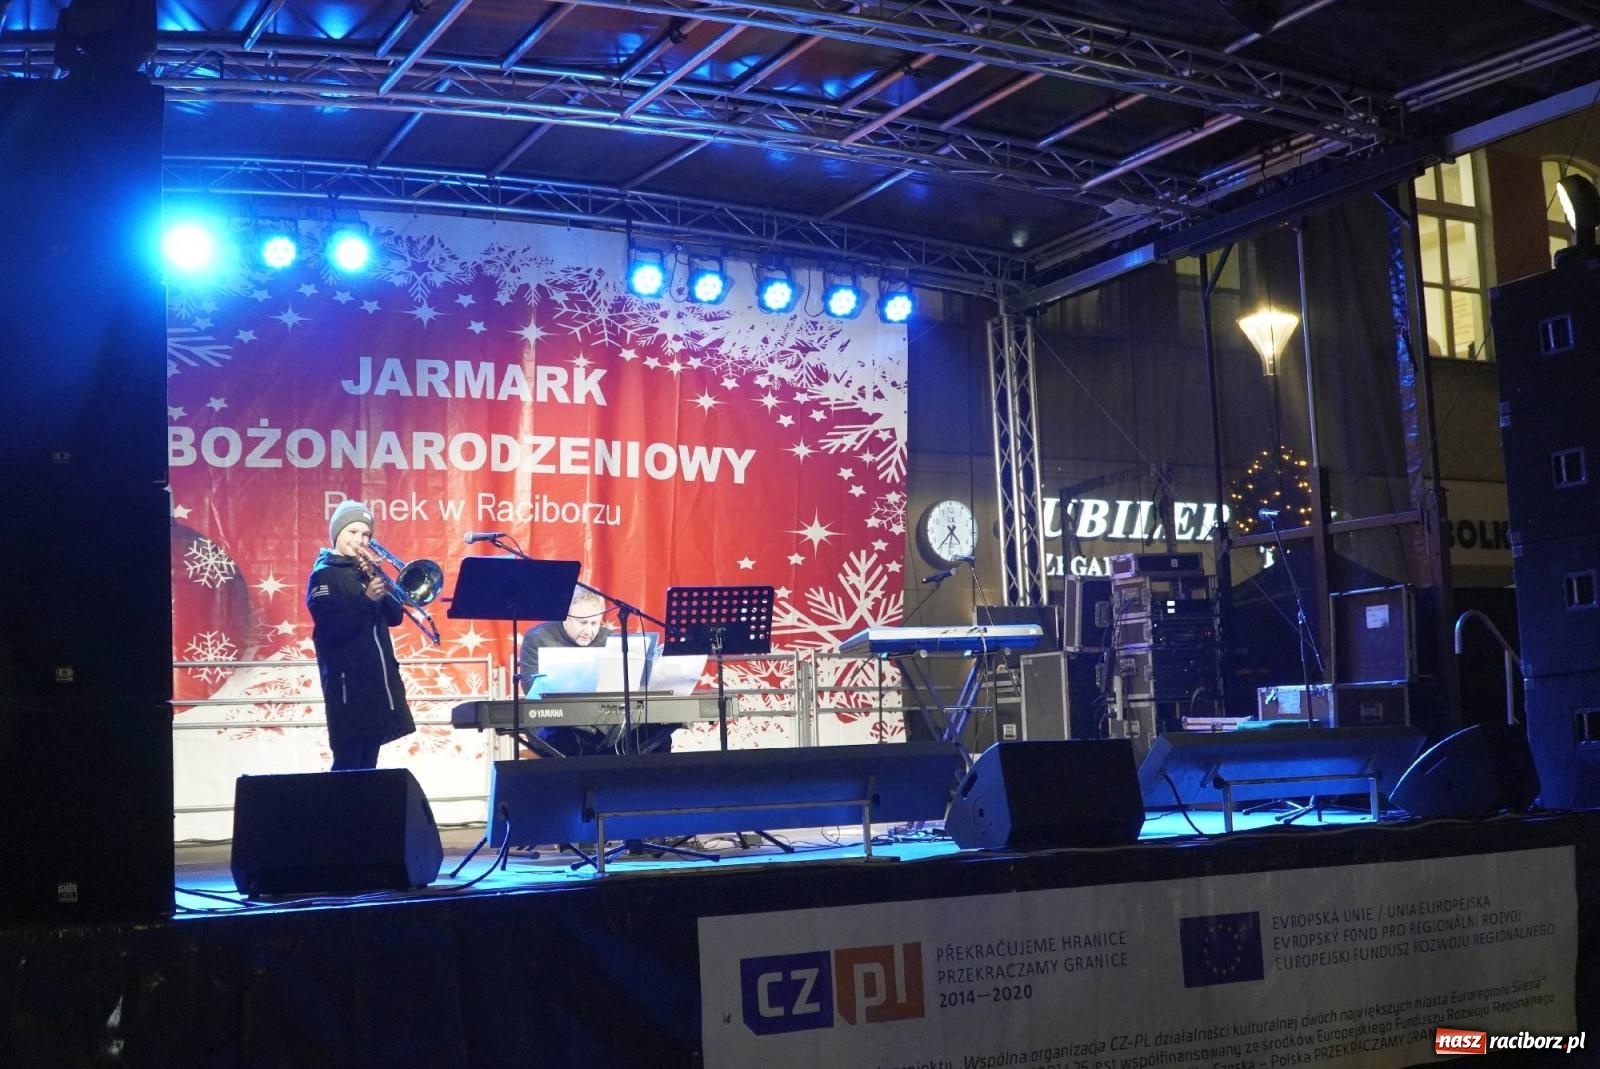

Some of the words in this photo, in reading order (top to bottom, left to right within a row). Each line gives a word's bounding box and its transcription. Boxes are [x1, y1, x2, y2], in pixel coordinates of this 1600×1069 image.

[342, 356, 608, 406] JARMARK
[167, 418, 757, 484] BOŻONARODZENIOWY
[324, 491, 427, 522] Rnek
[438, 501, 465, 522] w
[477, 493, 621, 525] Raciborzu
[1043, 498, 1230, 540] UBILER
[537, 709, 564, 718] YAMAHA
[1344, 908, 1373, 923] UNIE
[1387, 903, 1417, 919] UNIA
[1419, 895, 1490, 915] EUROPEJSKA
[936, 938, 1057, 961] PŘEKRAČUJEME
[1062, 930, 1128, 951] HRANICE
[1275, 950, 1350, 970] EUROPEJSKI
[1354, 942, 1410, 961] FUNDUSZ
[1413, 935, 1470, 953] ROZWOJU
[1472, 923, 1556, 946] REGIONALNEGO
[1344, 927, 1378, 942] FOND
[1382, 924, 1405, 939] PRO
[938, 959, 1058, 984] PRZEKRACZAMY
[1064, 952, 1129, 972] GRANICE
[1031, 1041, 1105, 1064] organizacja
[1110, 1033, 1150, 1052] CZ-PL
[1154, 1024, 1229, 1047] działalności
[1232, 1017, 1298, 1037] kulturalnej
[1301, 1010, 1337, 1028] dwóch
[1414, 994, 1448, 1011] miasta
[1246, 1041, 1259, 1054] ze
[1271, 1052, 1311, 1068] Polska
